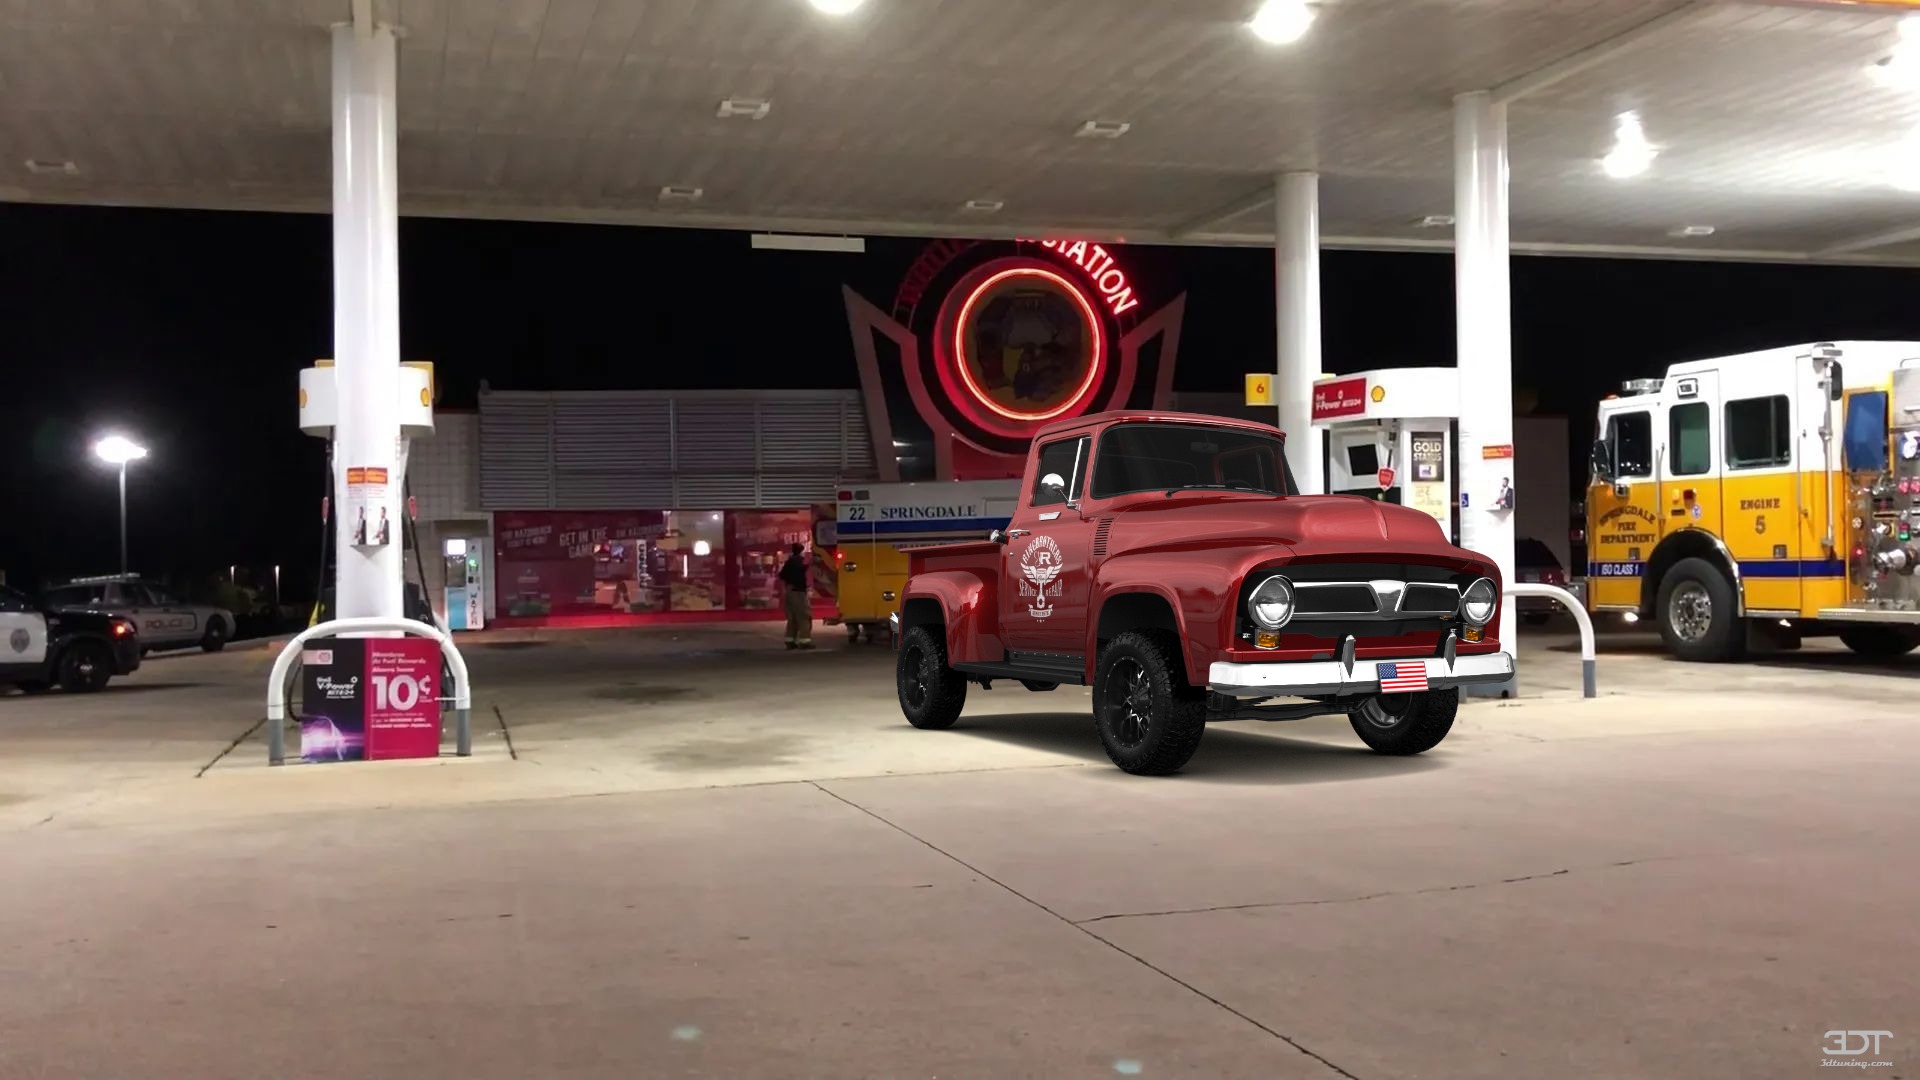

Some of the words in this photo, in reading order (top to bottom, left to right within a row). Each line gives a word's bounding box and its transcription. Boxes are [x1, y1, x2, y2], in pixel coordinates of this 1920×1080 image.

[1256, 383, 1265, 394] 6
[1315, 400, 1341, 411] V-Power
[1413, 442, 1441, 453] GOLD
[1413, 453, 1441, 462] STATUS
[1740, 497, 1780, 510] ENGINE
[849, 506, 865, 521] 22
[881, 504, 977, 520] SPRINGDALE
[1600, 505, 1656, 527] SPRINGDALE
[1617, 522, 1636, 531] FIRE
[1755, 515, 1766, 535] 5
[559, 532, 576, 547] GET
[578, 530, 589, 544] IN
[591, 527, 609, 542] THE
[1600, 533, 1656, 544] DEPARTMENT
[1040, 552, 1052, 565] R
[1601, 563, 1613, 576] ISO
[1613, 563, 1634, 576] CLASS
[1019, 578, 1038, 597] SERVICE
[1046, 578, 1063, 597] REPAIR
[145, 619, 184, 629] POLICE
[317, 682, 355, 690] V-Power
[372, 674, 431, 710] 10¢
